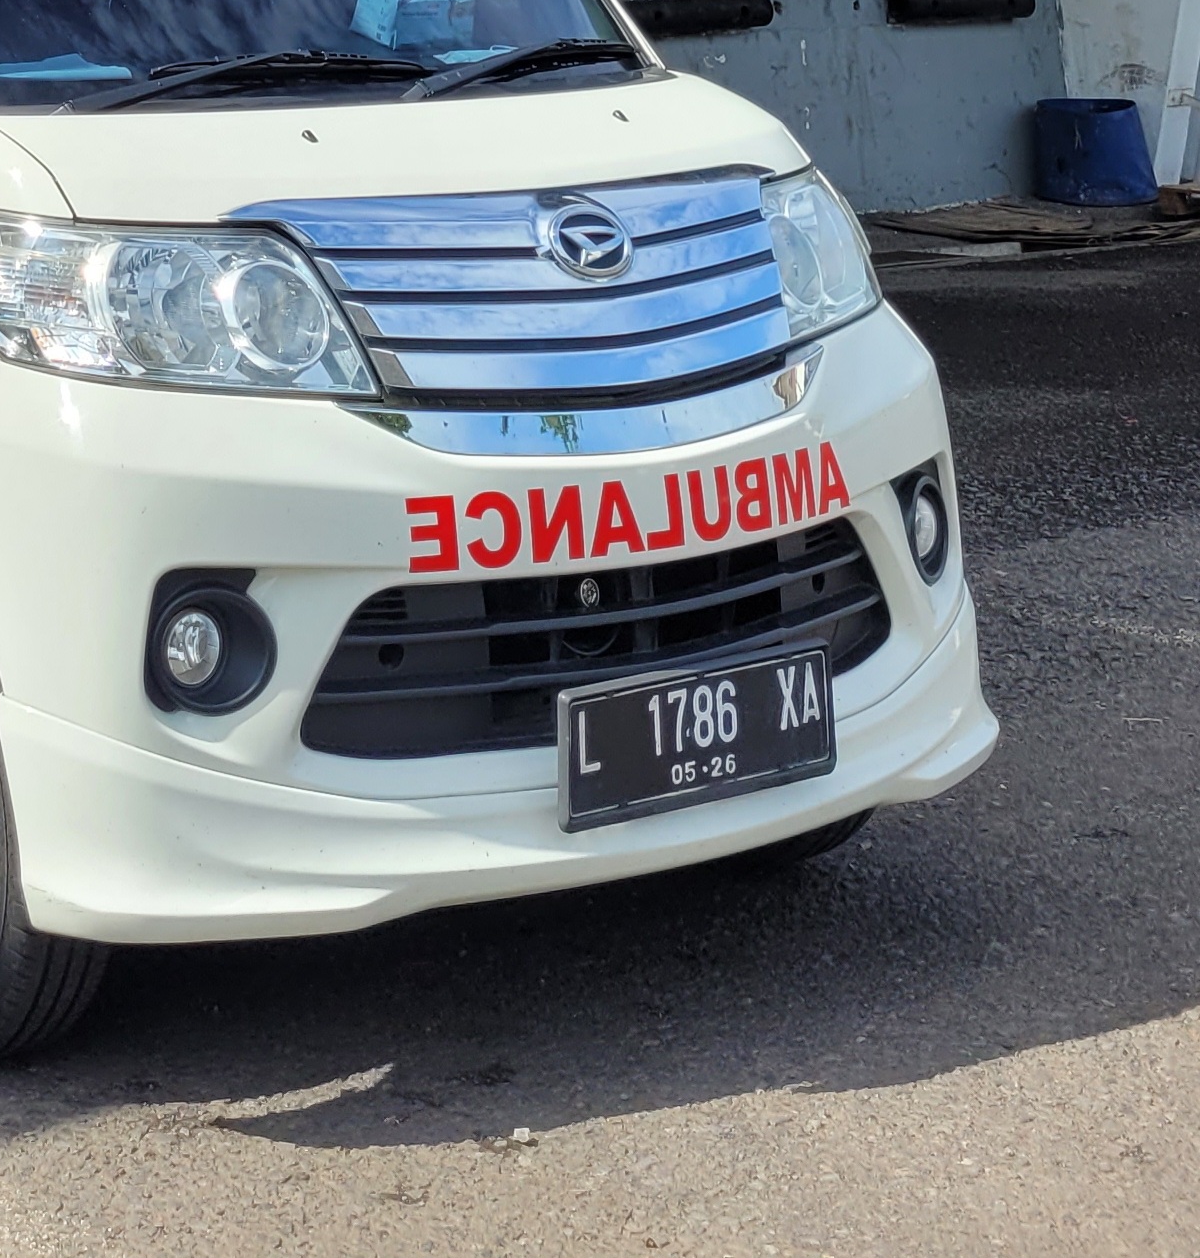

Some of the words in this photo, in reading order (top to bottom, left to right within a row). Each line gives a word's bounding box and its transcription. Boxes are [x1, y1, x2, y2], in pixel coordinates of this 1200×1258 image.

[578, 710, 601, 775] L
[648, 680, 738, 757] 1786
[776, 661, 821, 731] XA
